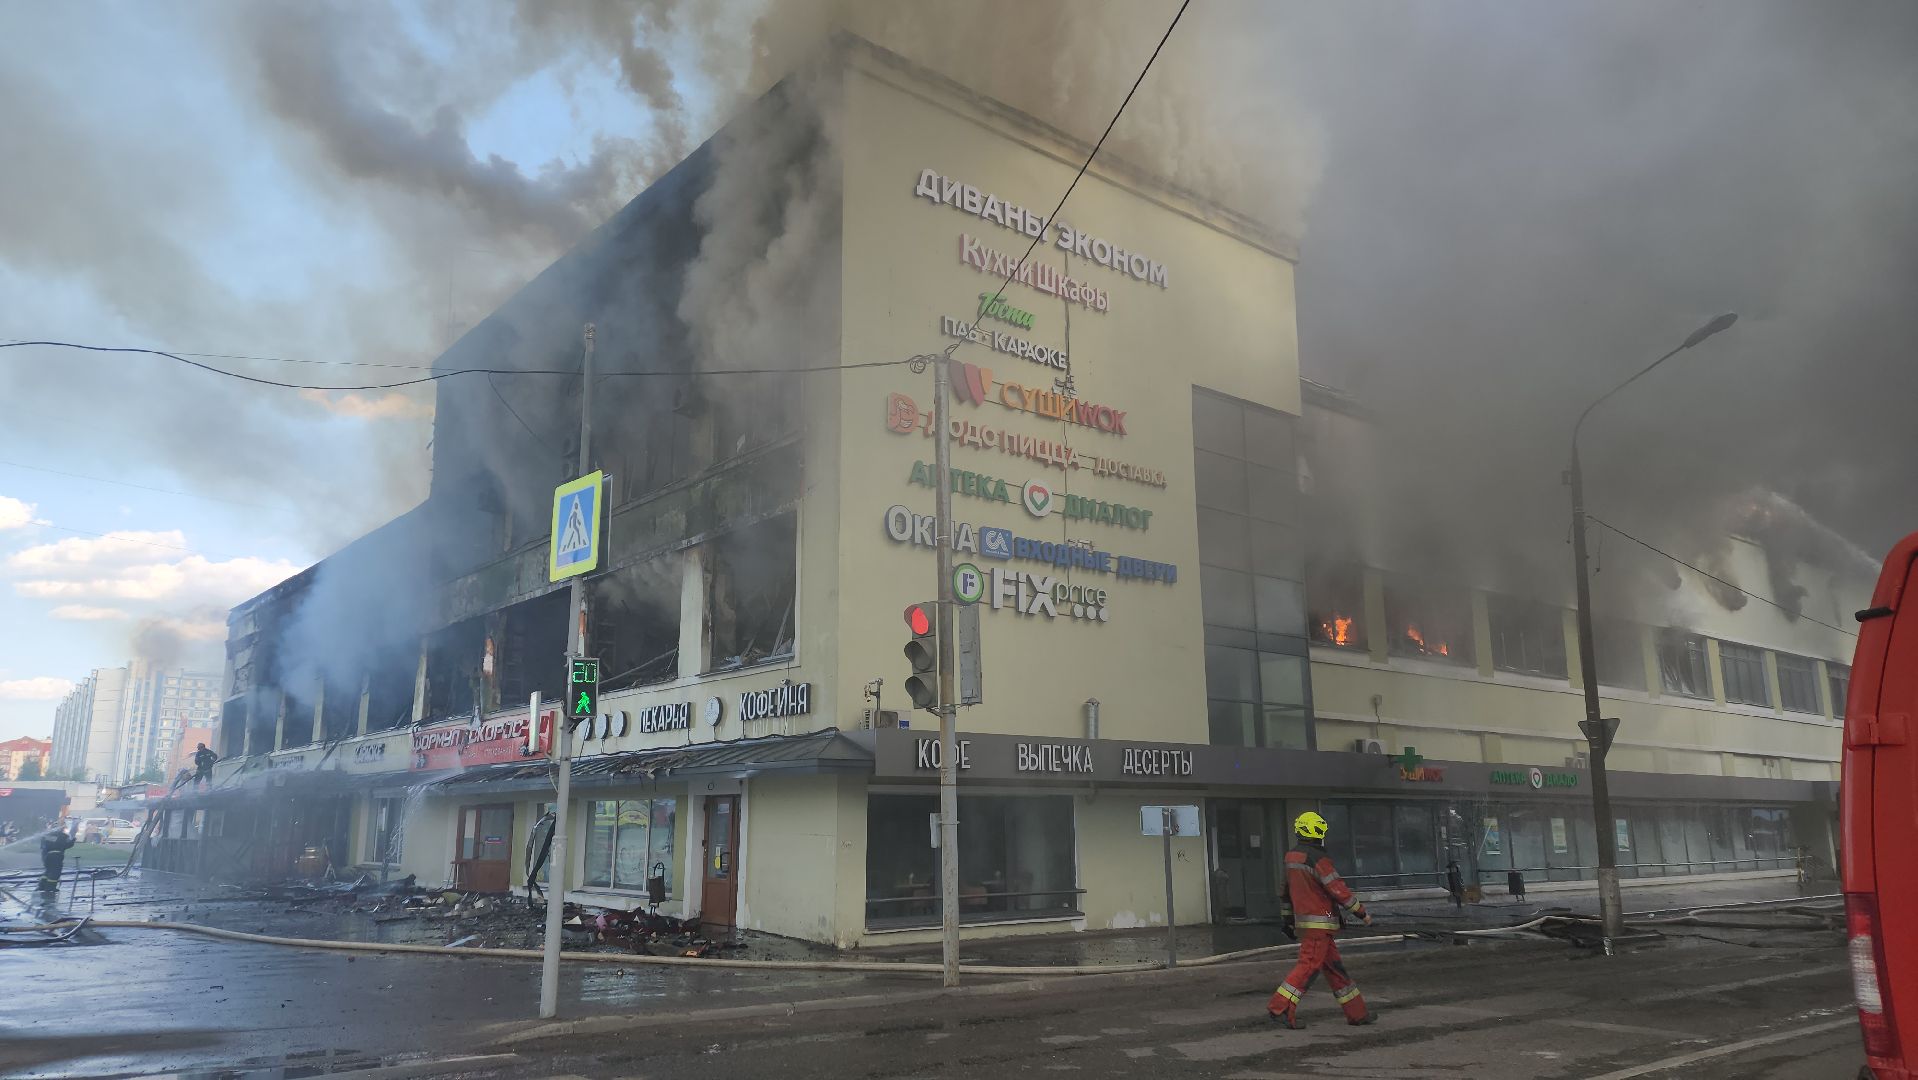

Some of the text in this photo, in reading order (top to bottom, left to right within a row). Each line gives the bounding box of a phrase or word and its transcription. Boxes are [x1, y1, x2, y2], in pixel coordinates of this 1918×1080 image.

[916, 168, 1168, 288] ДИВАНЫ ЭКОНОМ
[1096, 456, 1167, 487] ДОСТАВКА
[1063, 494, 1153, 530] ДИАЛОГ
[1014, 537, 1111, 572] ВХОДНЫЕ
[1117, 556, 1177, 583] ДВЕРИ
[573, 662, 597, 682] 20
[640, 679, 811, 733] ПЕКАРНЯ КОФЕЙНЯ
[1017, 743, 1093, 773] ВЫПЕЧКА
[1122, 748, 1193, 775] ДЕСЕРТЫ
